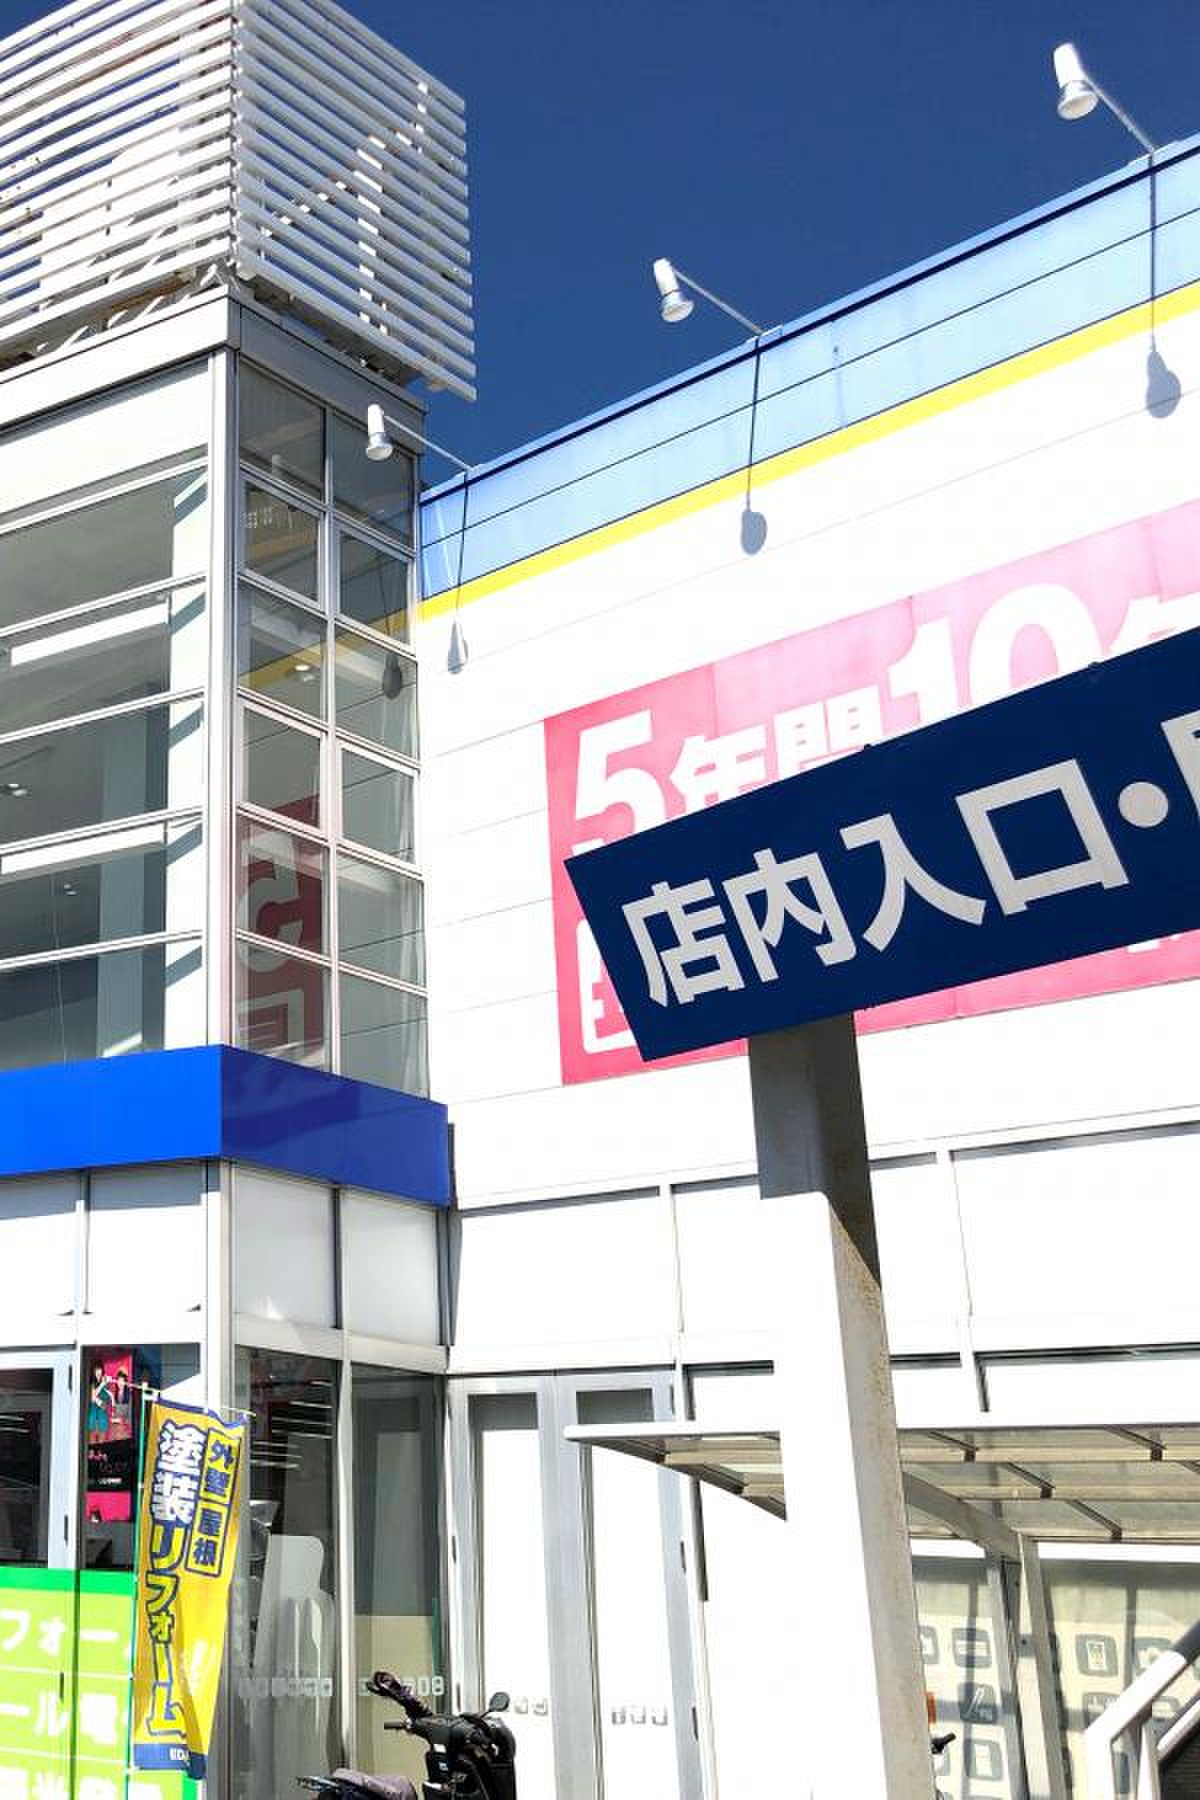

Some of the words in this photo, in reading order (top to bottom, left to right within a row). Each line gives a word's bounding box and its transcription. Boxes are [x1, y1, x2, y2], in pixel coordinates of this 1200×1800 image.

[622, 711, 1200, 1006] 店内入口・
[193, 1506, 223, 1567] 屋根
